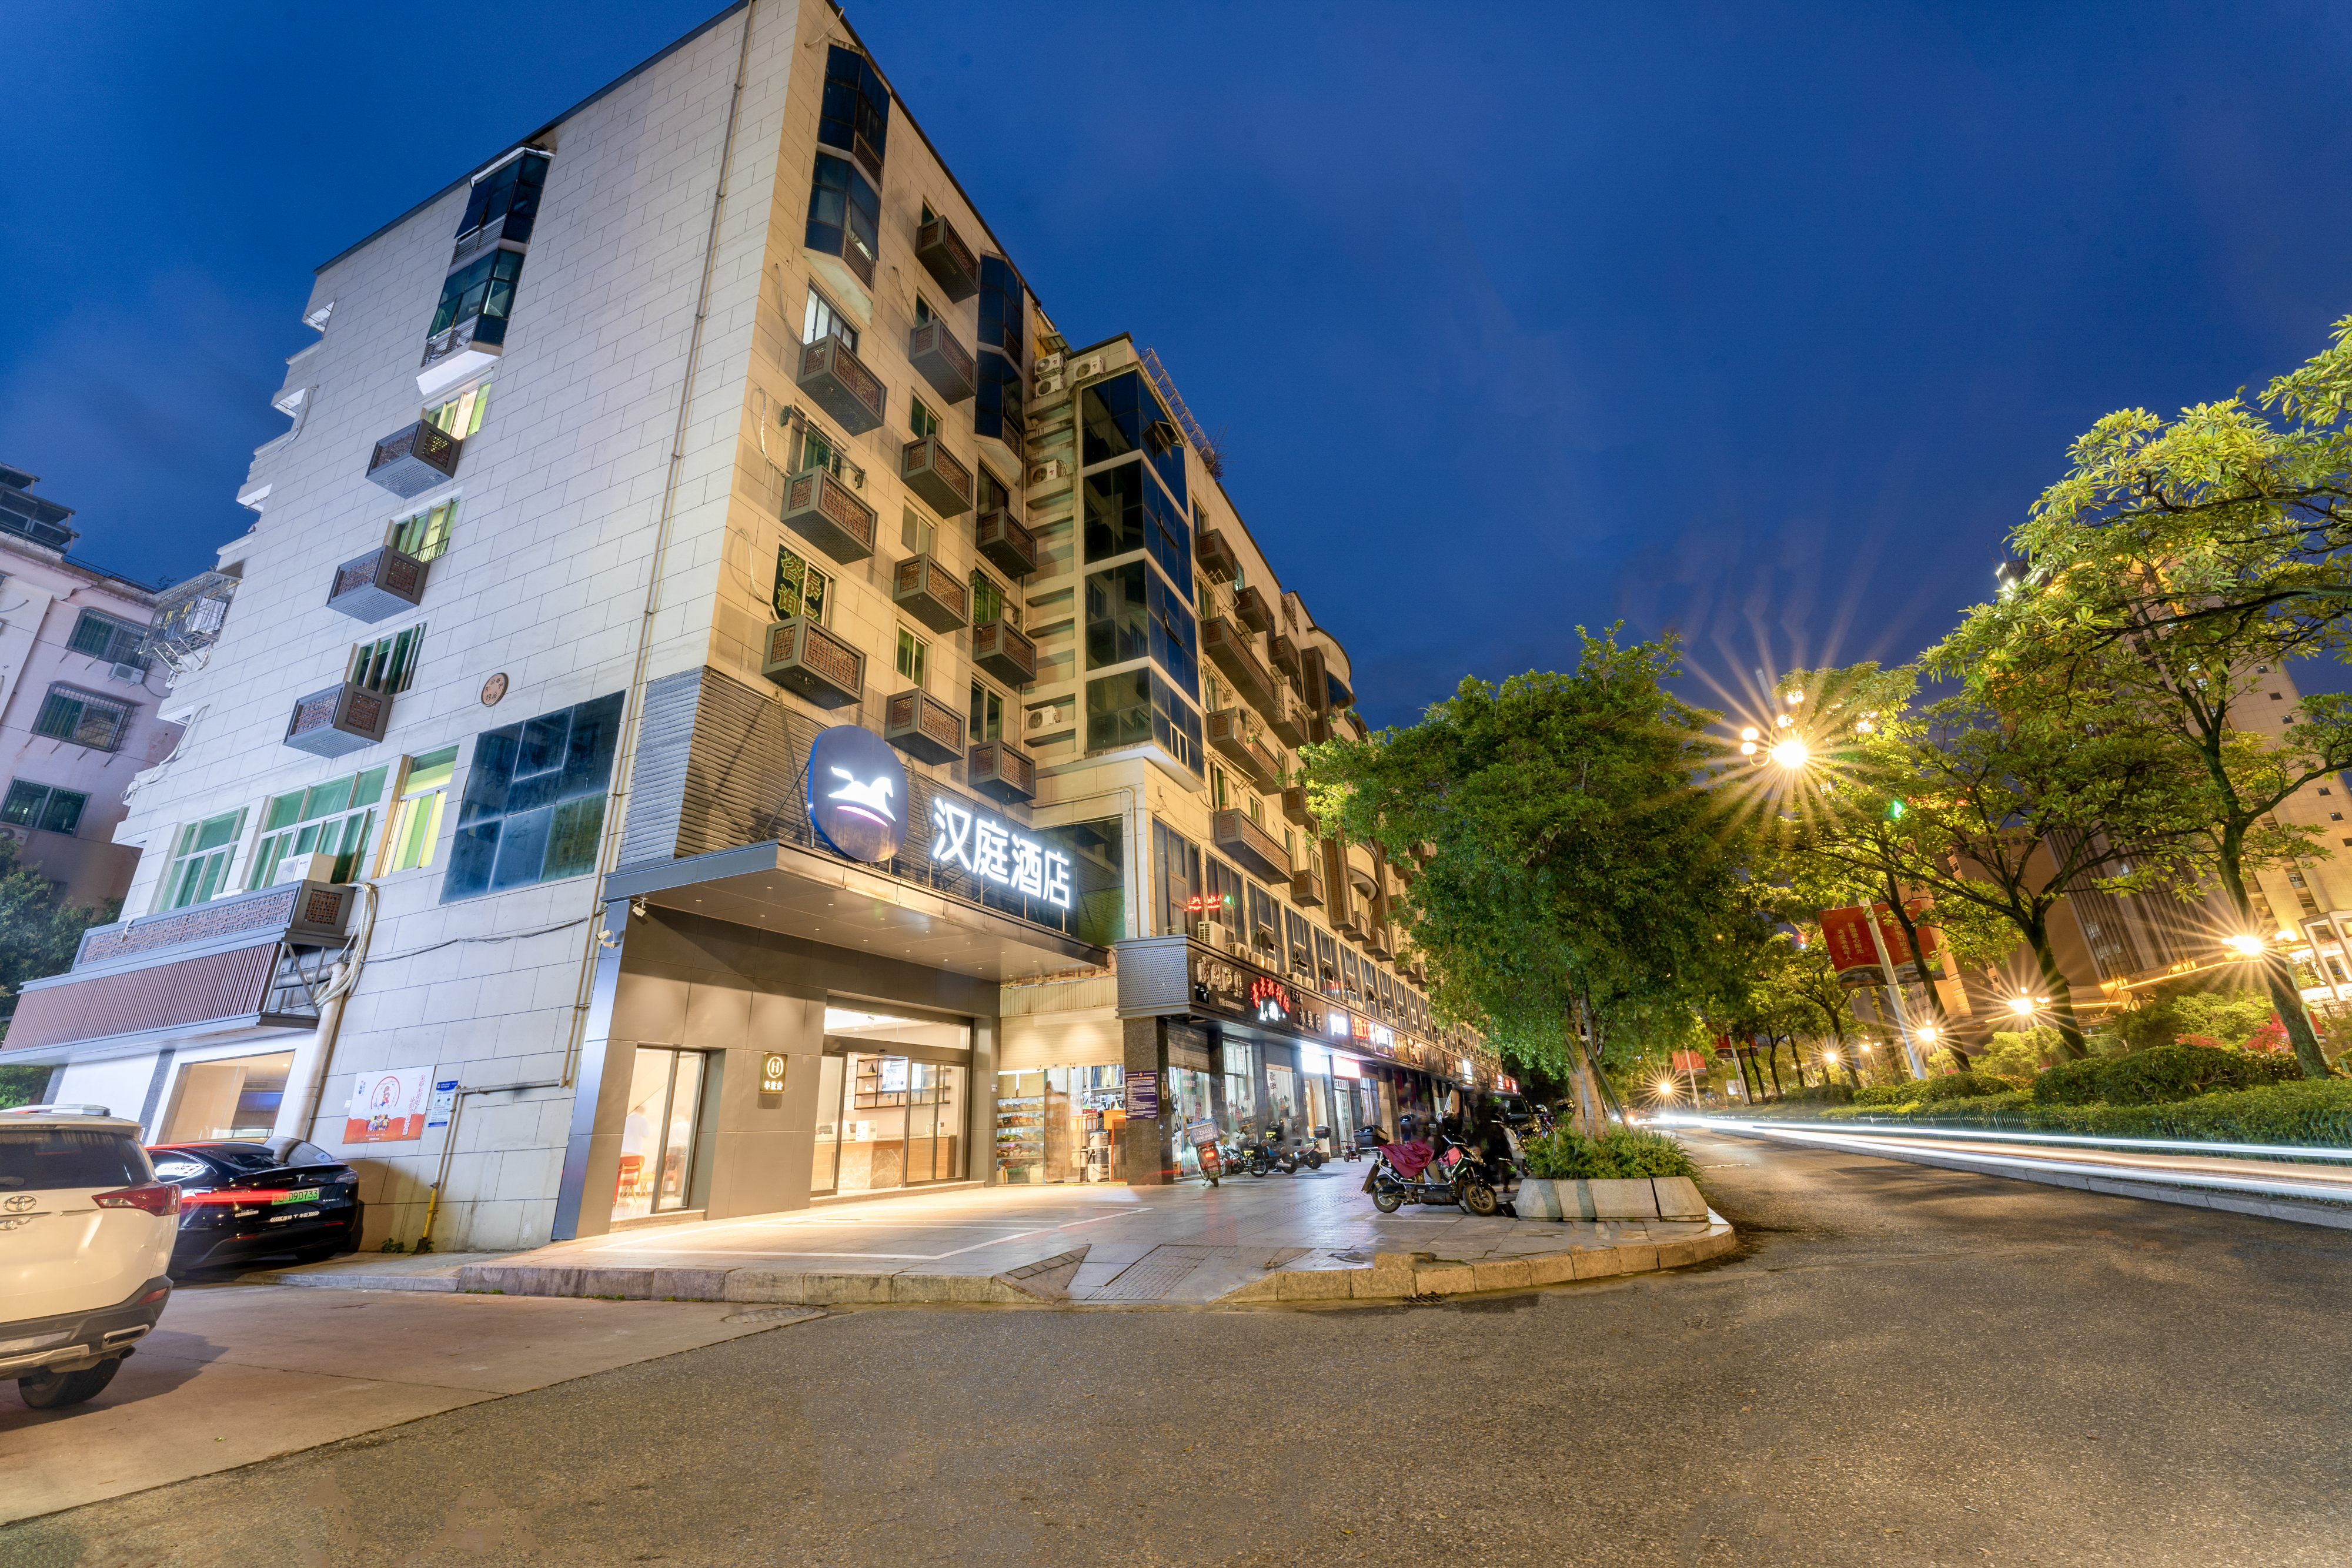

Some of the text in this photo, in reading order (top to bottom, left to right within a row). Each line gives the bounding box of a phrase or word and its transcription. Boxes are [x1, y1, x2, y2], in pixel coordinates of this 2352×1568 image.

[777, 551, 804, 617] 咨询
[932, 797, 1069, 908] 汉庭酒店
[1837, 929, 1853, 961] 关爱未成年人
[1847, 922, 1864, 954] 播撒爱心阳光
[1299, 1007, 1321, 1032] 水果店
[764, 1081, 783, 1090] 华住会
